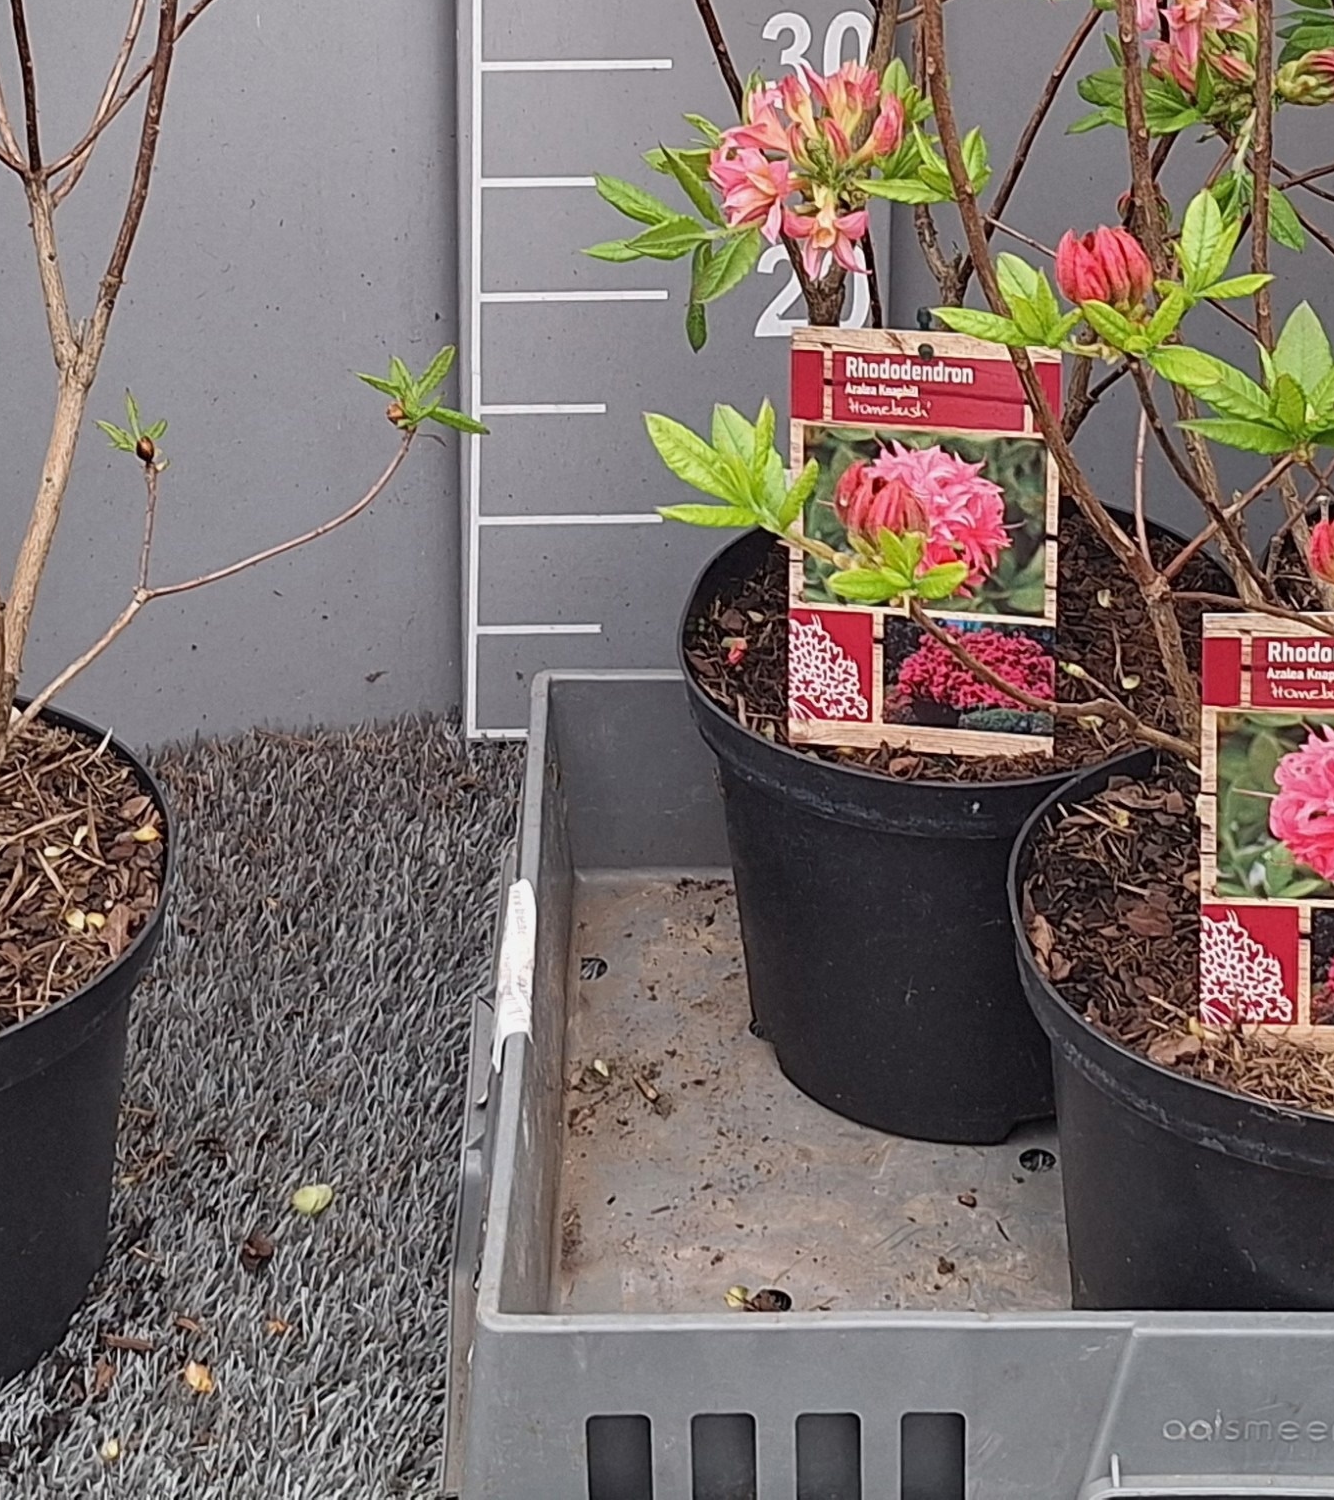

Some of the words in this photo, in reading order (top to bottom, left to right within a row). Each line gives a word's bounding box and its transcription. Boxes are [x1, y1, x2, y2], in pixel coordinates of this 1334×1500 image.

[845, 356, 974, 384] Rhododendron
[844, 381, 877, 396] Azalea
[878, 383, 919, 400] Knaphill
[1266, 667, 1305, 680] Azalea
